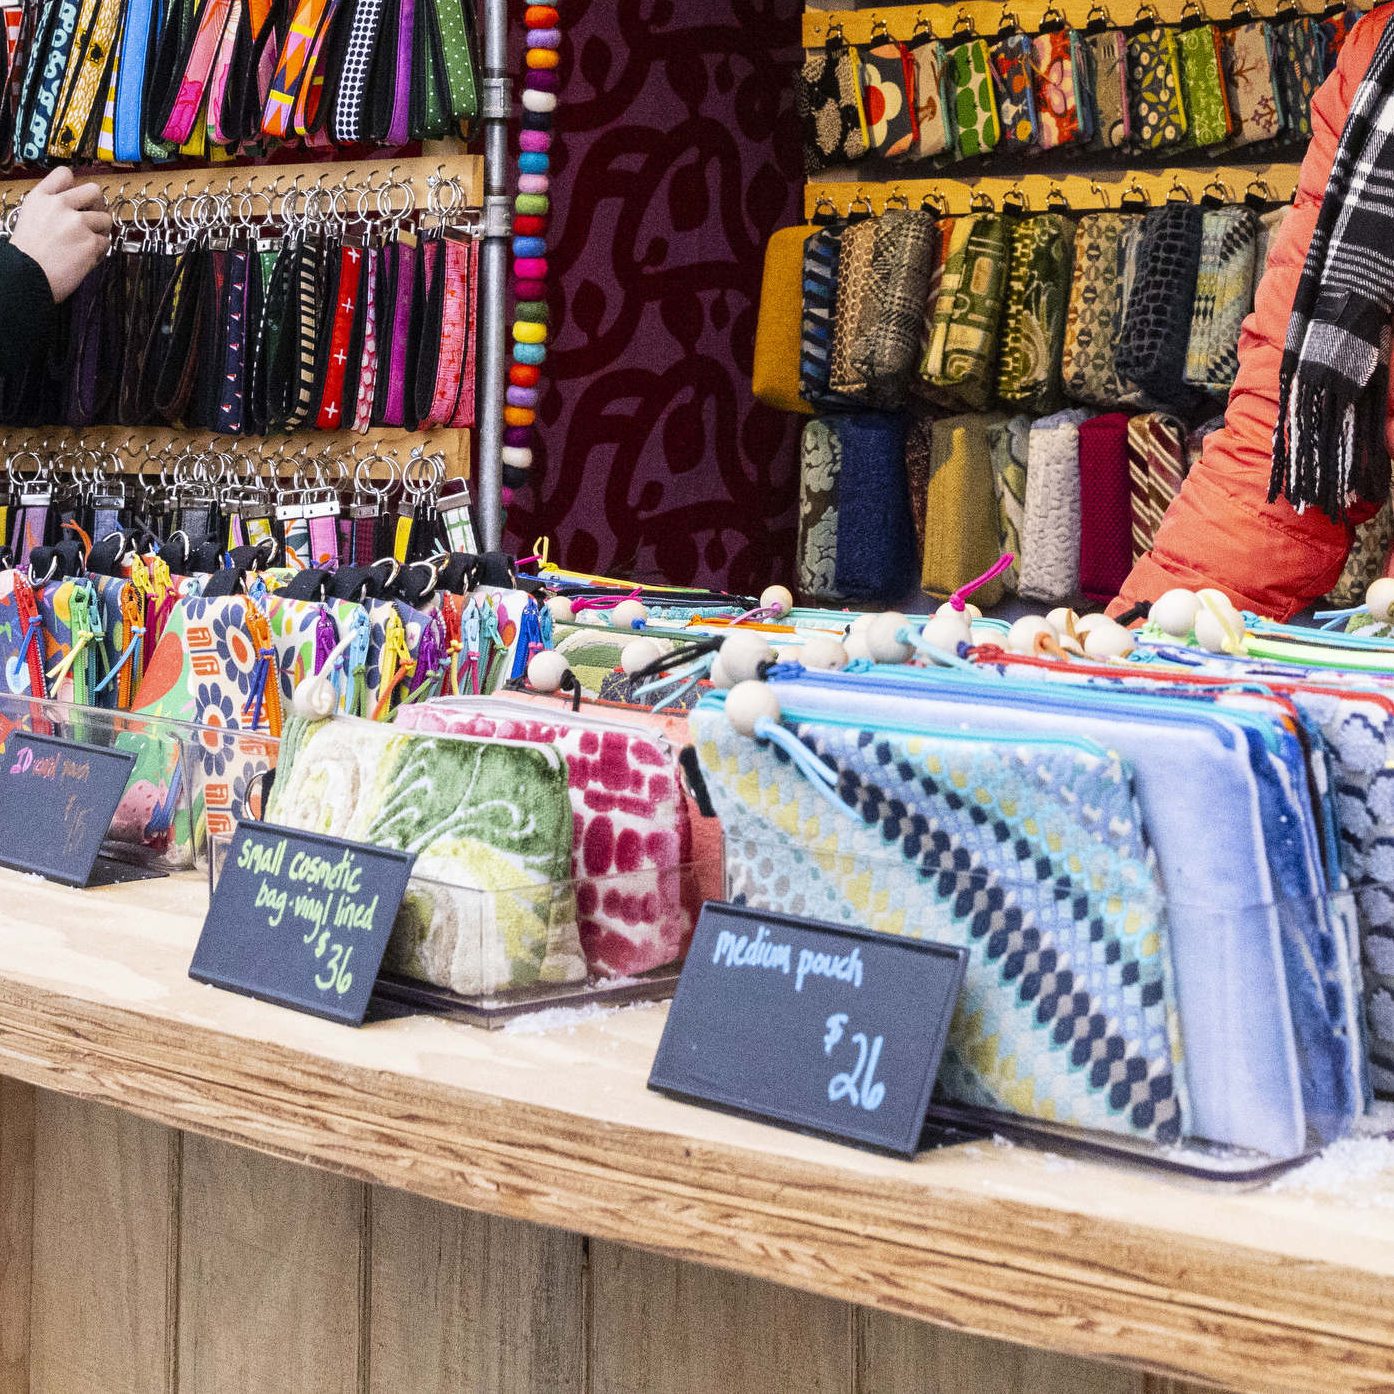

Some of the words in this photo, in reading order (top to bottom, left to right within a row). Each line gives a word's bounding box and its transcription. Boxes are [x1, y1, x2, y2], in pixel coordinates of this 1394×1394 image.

[289, 849, 363, 894] cosmetic
[333, 894, 379, 931] lined
[315, 929, 353, 995] $36
[795, 947, 864, 992] pouch
[823, 1013, 887, 1111] $26
